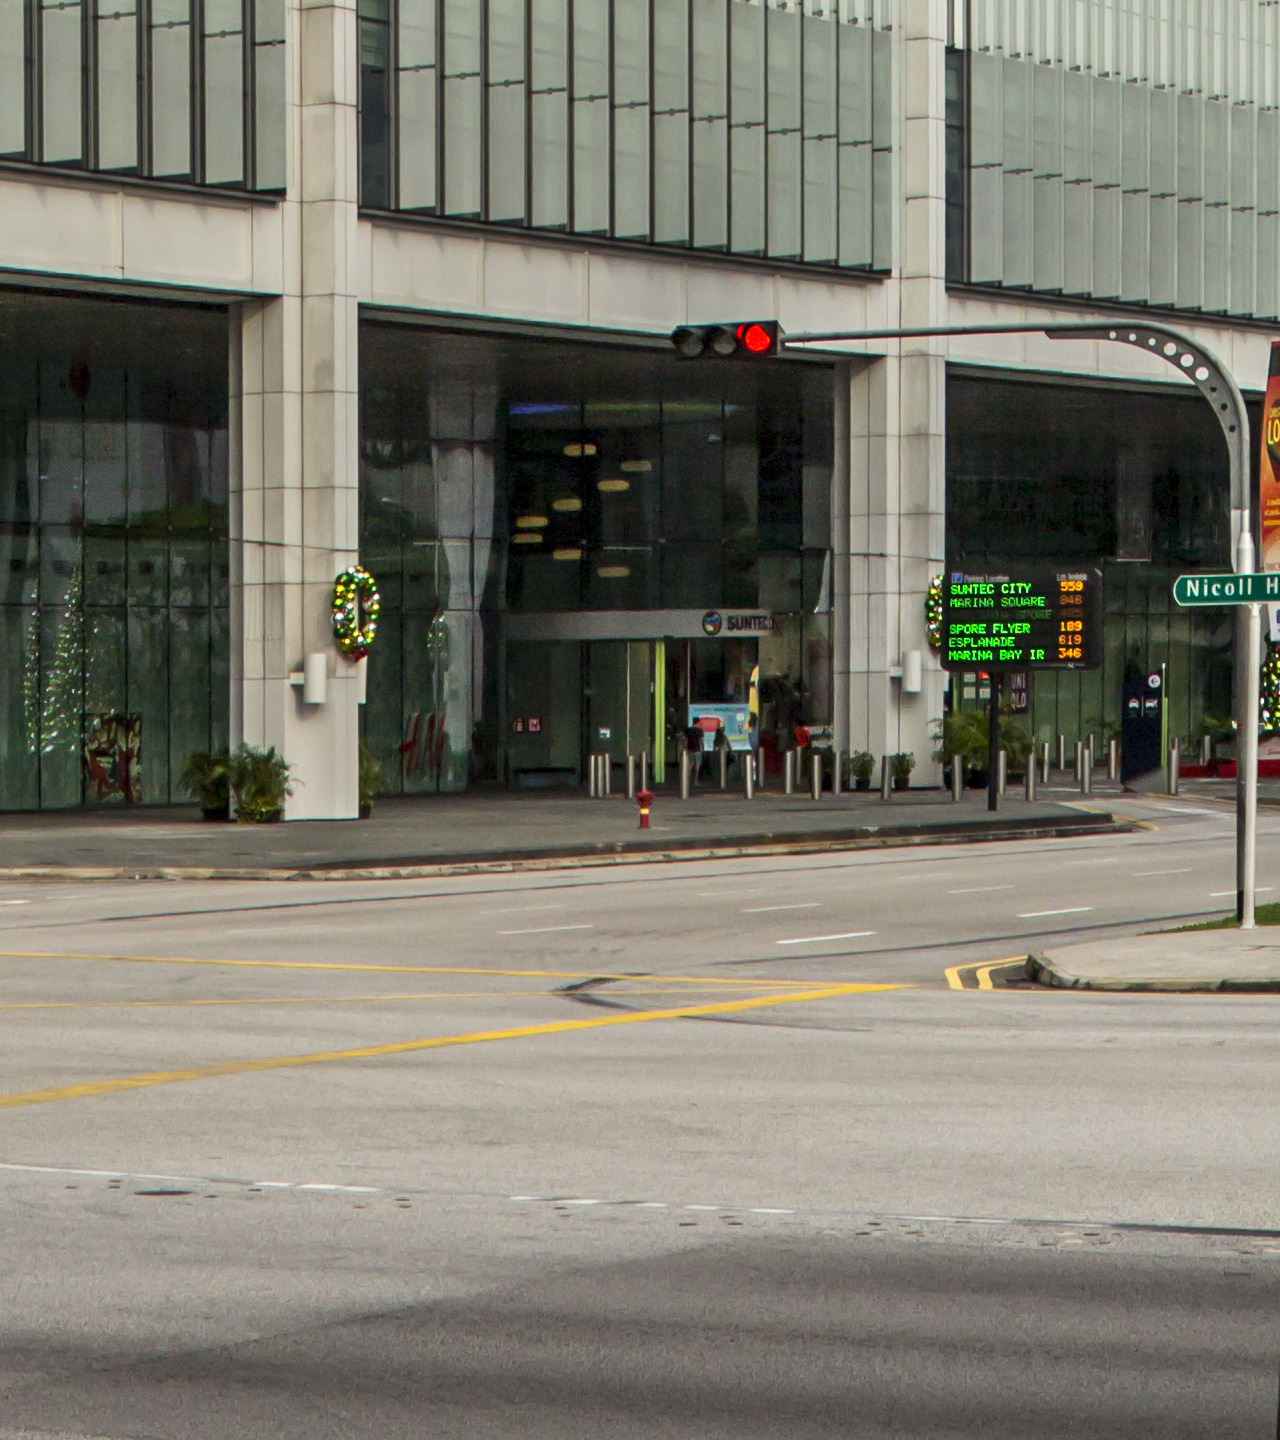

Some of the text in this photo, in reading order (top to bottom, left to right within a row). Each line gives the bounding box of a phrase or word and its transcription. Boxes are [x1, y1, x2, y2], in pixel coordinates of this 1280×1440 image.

[950, 583, 1032, 595] SUNTEC CITY
[1060, 581, 1084, 592] 559
[1186, 578, 1252, 597] Nicoll
[950, 596, 1046, 608] MARINA SQUARE
[949, 623, 1031, 635] SPORE FLYER
[949, 637, 1016, 648] ESPLANADE
[948, 649, 1045, 661] MARINA BAY IR
[1058, 647, 1082, 659] 346
